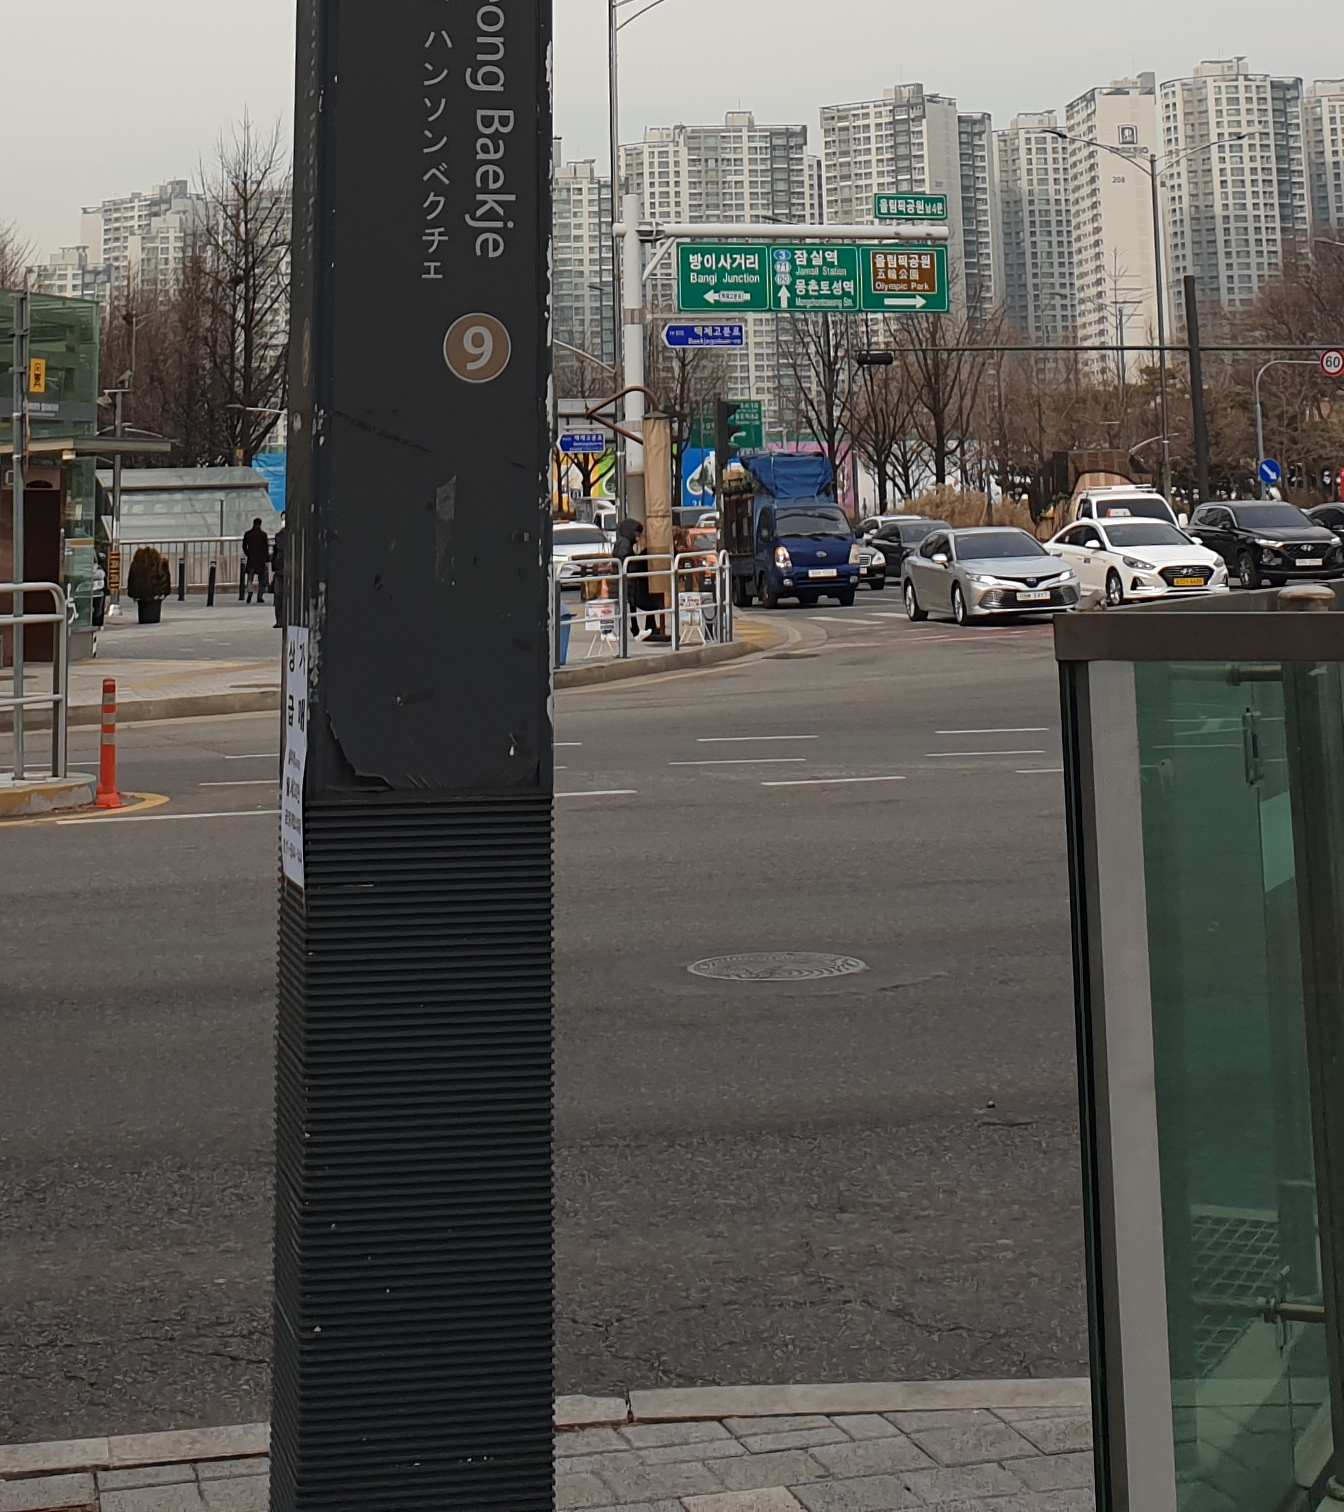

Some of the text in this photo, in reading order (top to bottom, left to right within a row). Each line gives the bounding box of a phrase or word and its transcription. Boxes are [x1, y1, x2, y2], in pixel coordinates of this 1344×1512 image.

[464, 108, 516, 258] Baekje
[689, 253, 759, 270] 방이사거리
[779, 250, 786, 260] 3
[794, 249, 838, 266] 잠실역
[875, 254, 931, 268] 올림픽공원
[822, 266, 847, 276] Station
[690, 272, 760, 285] Bangi Junction
[795, 279, 854, 296] 몽촌토성역
[875, 282, 929, 291] Olympic Park
[461, 325, 495, 371] 9
[1325, 356, 1341, 368] 60
